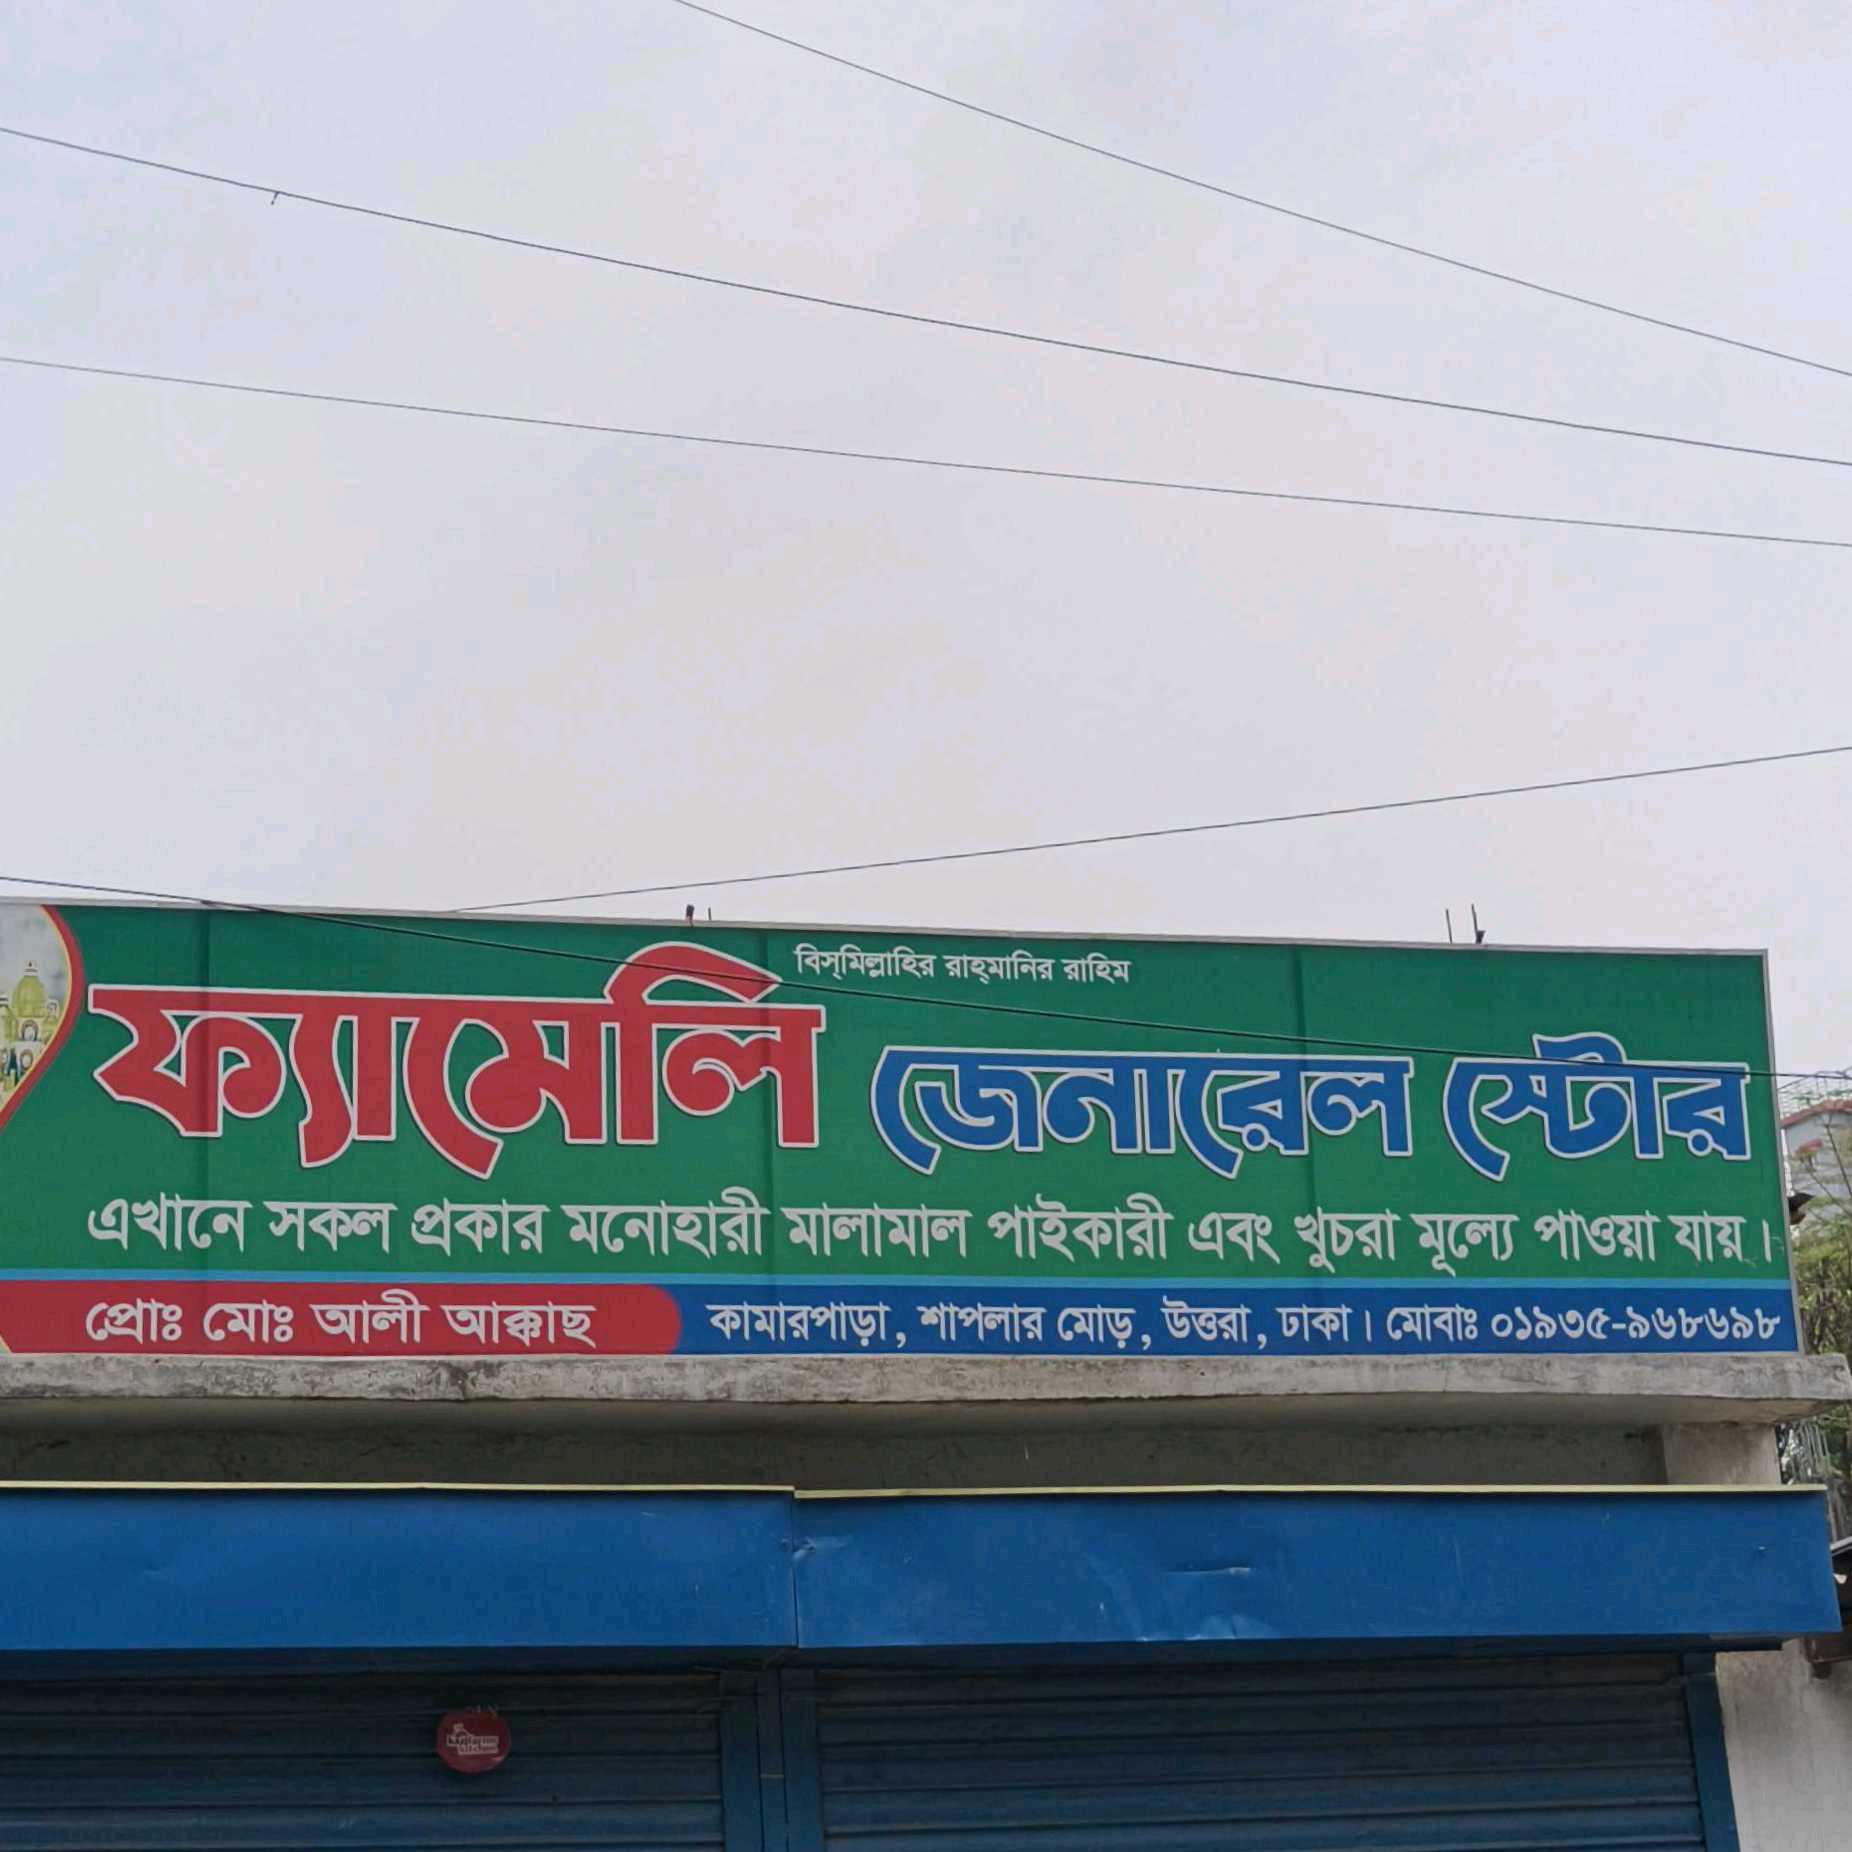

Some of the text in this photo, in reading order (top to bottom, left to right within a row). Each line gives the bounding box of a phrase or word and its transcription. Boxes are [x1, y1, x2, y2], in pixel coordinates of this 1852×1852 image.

[1062, 953, 1132, 984] রাহিম
[88, 942, 1752, 1183] ফ্যামেলি জেনারেল স্টোর
[88, 1192, 253, 1252] এখানে
[263, 1201, 398, 1254] সকল
[411, 1197, 550, 1257] প্রকার
[560, 1186, 771, 1258] মনোহারী
[780, 1203, 973, 1258] মালামাল
[987, 1192, 1174, 1262] পাইকারী
[1188, 1212, 1280, 1264] এবং
[1294, 1206, 1401, 1274] খুচরা
[1409, 1213, 1519, 1277] মূল্যে
[1534, 1209, 1661, 1262] পাওয়া
[203, 1299, 295, 1344] মোঃ
[309, 1288, 430, 1344] আলী
[441, 1301, 597, 1348] আক্কাছ
[917, 1303, 1047, 1342] শাপলার
[1491, 1305, 1781, 1341] ০১৯৩৫-৯৬৮৬৯৮
